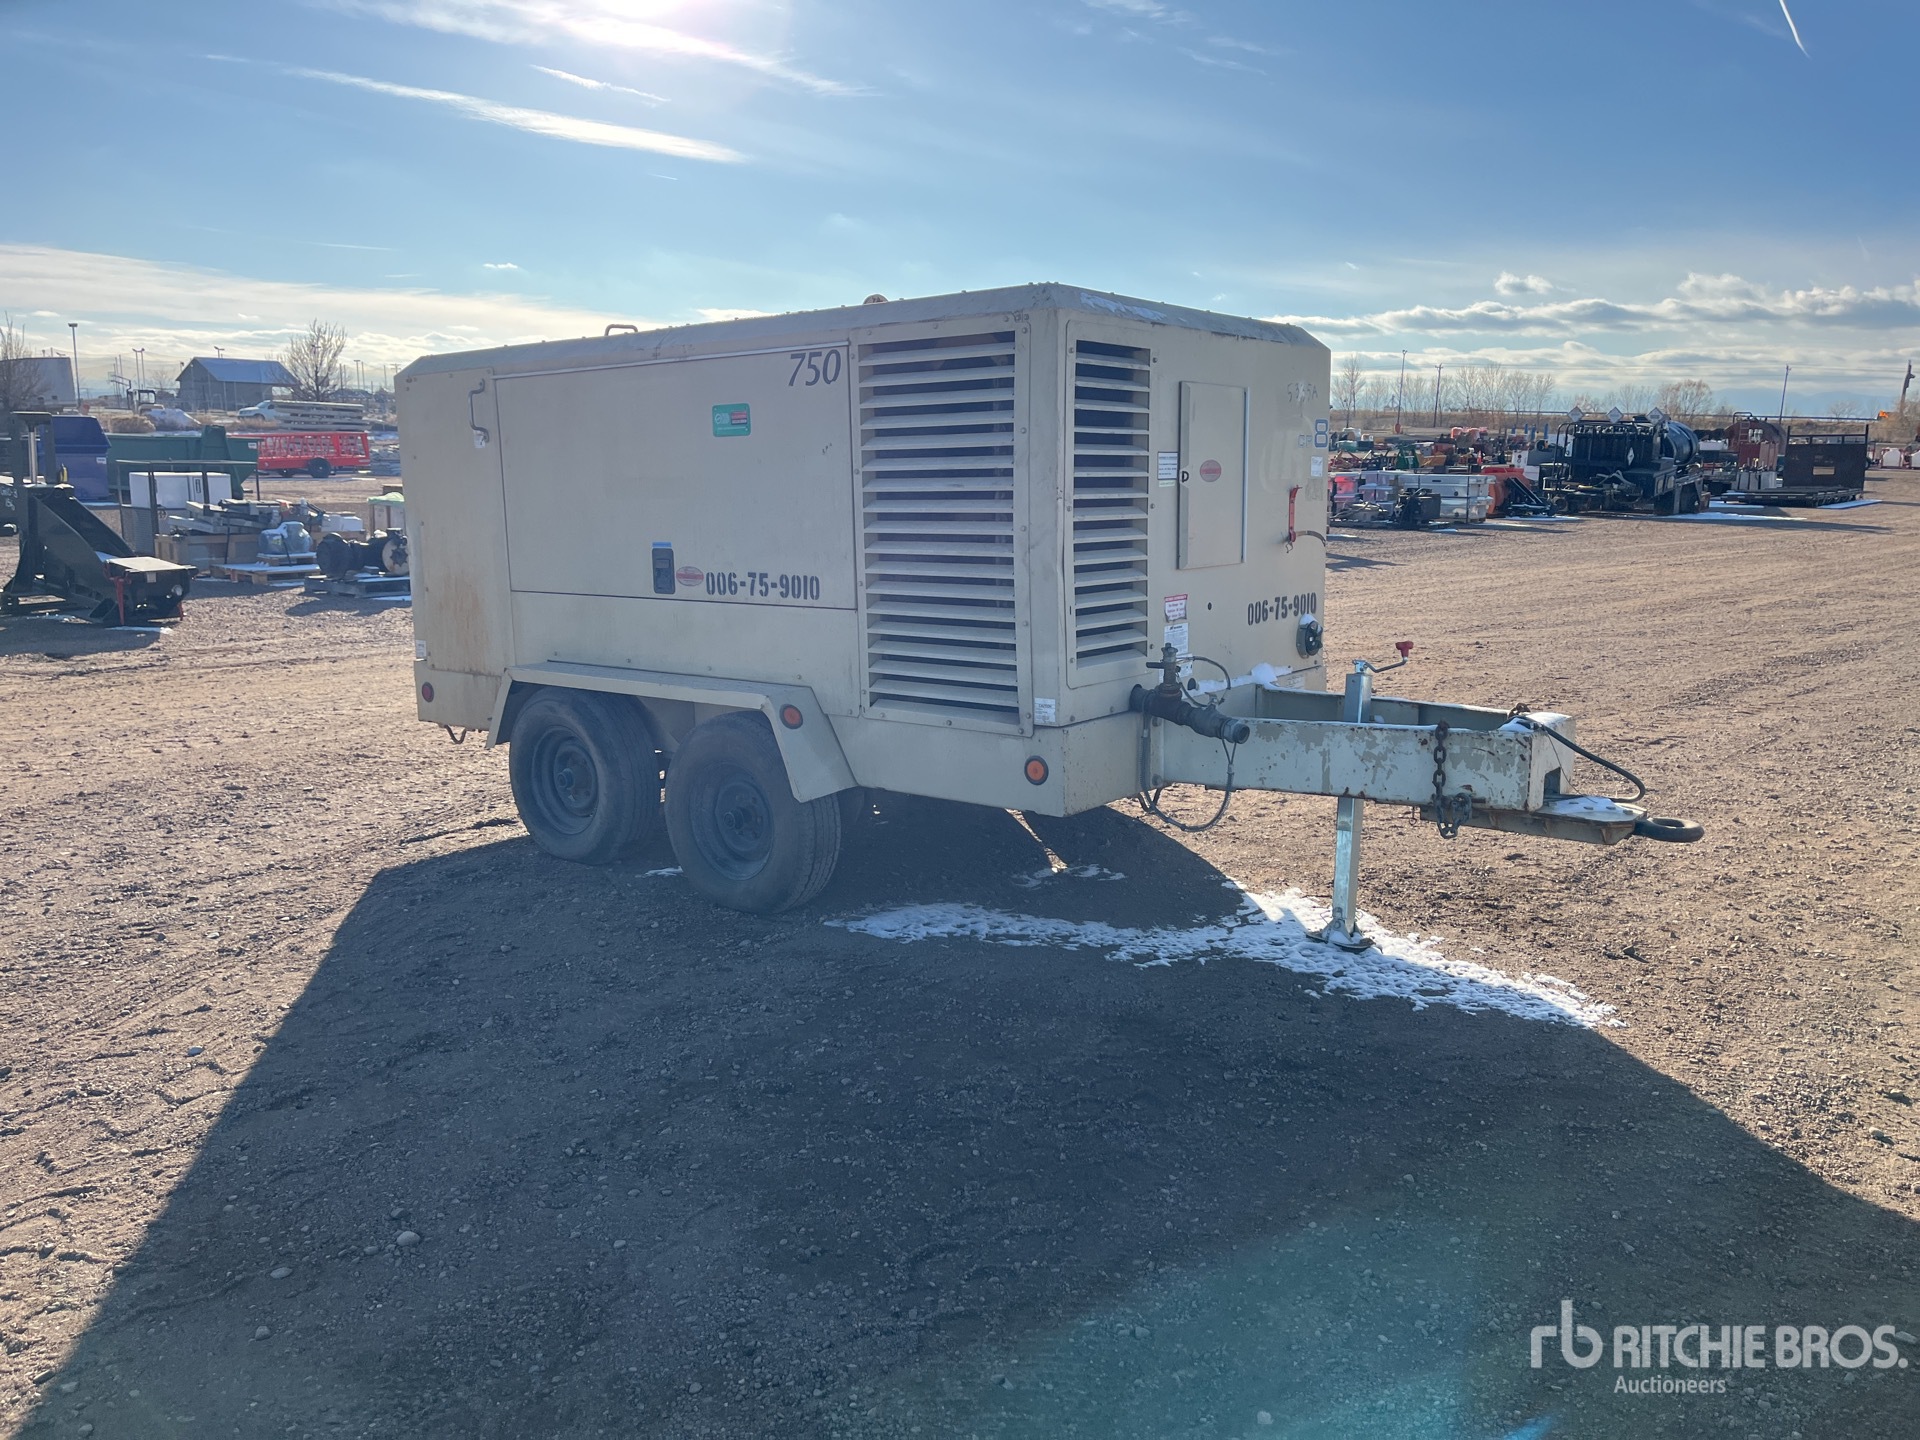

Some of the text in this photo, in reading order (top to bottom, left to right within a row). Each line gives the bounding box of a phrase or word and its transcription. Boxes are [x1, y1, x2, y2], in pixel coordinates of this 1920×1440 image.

[788, 349, 841, 387] 750
[1315, 418, 1329, 448] 8
[706, 571, 820, 600] 006-75-9010
[1247, 592, 1317, 625] 006-75-9010
